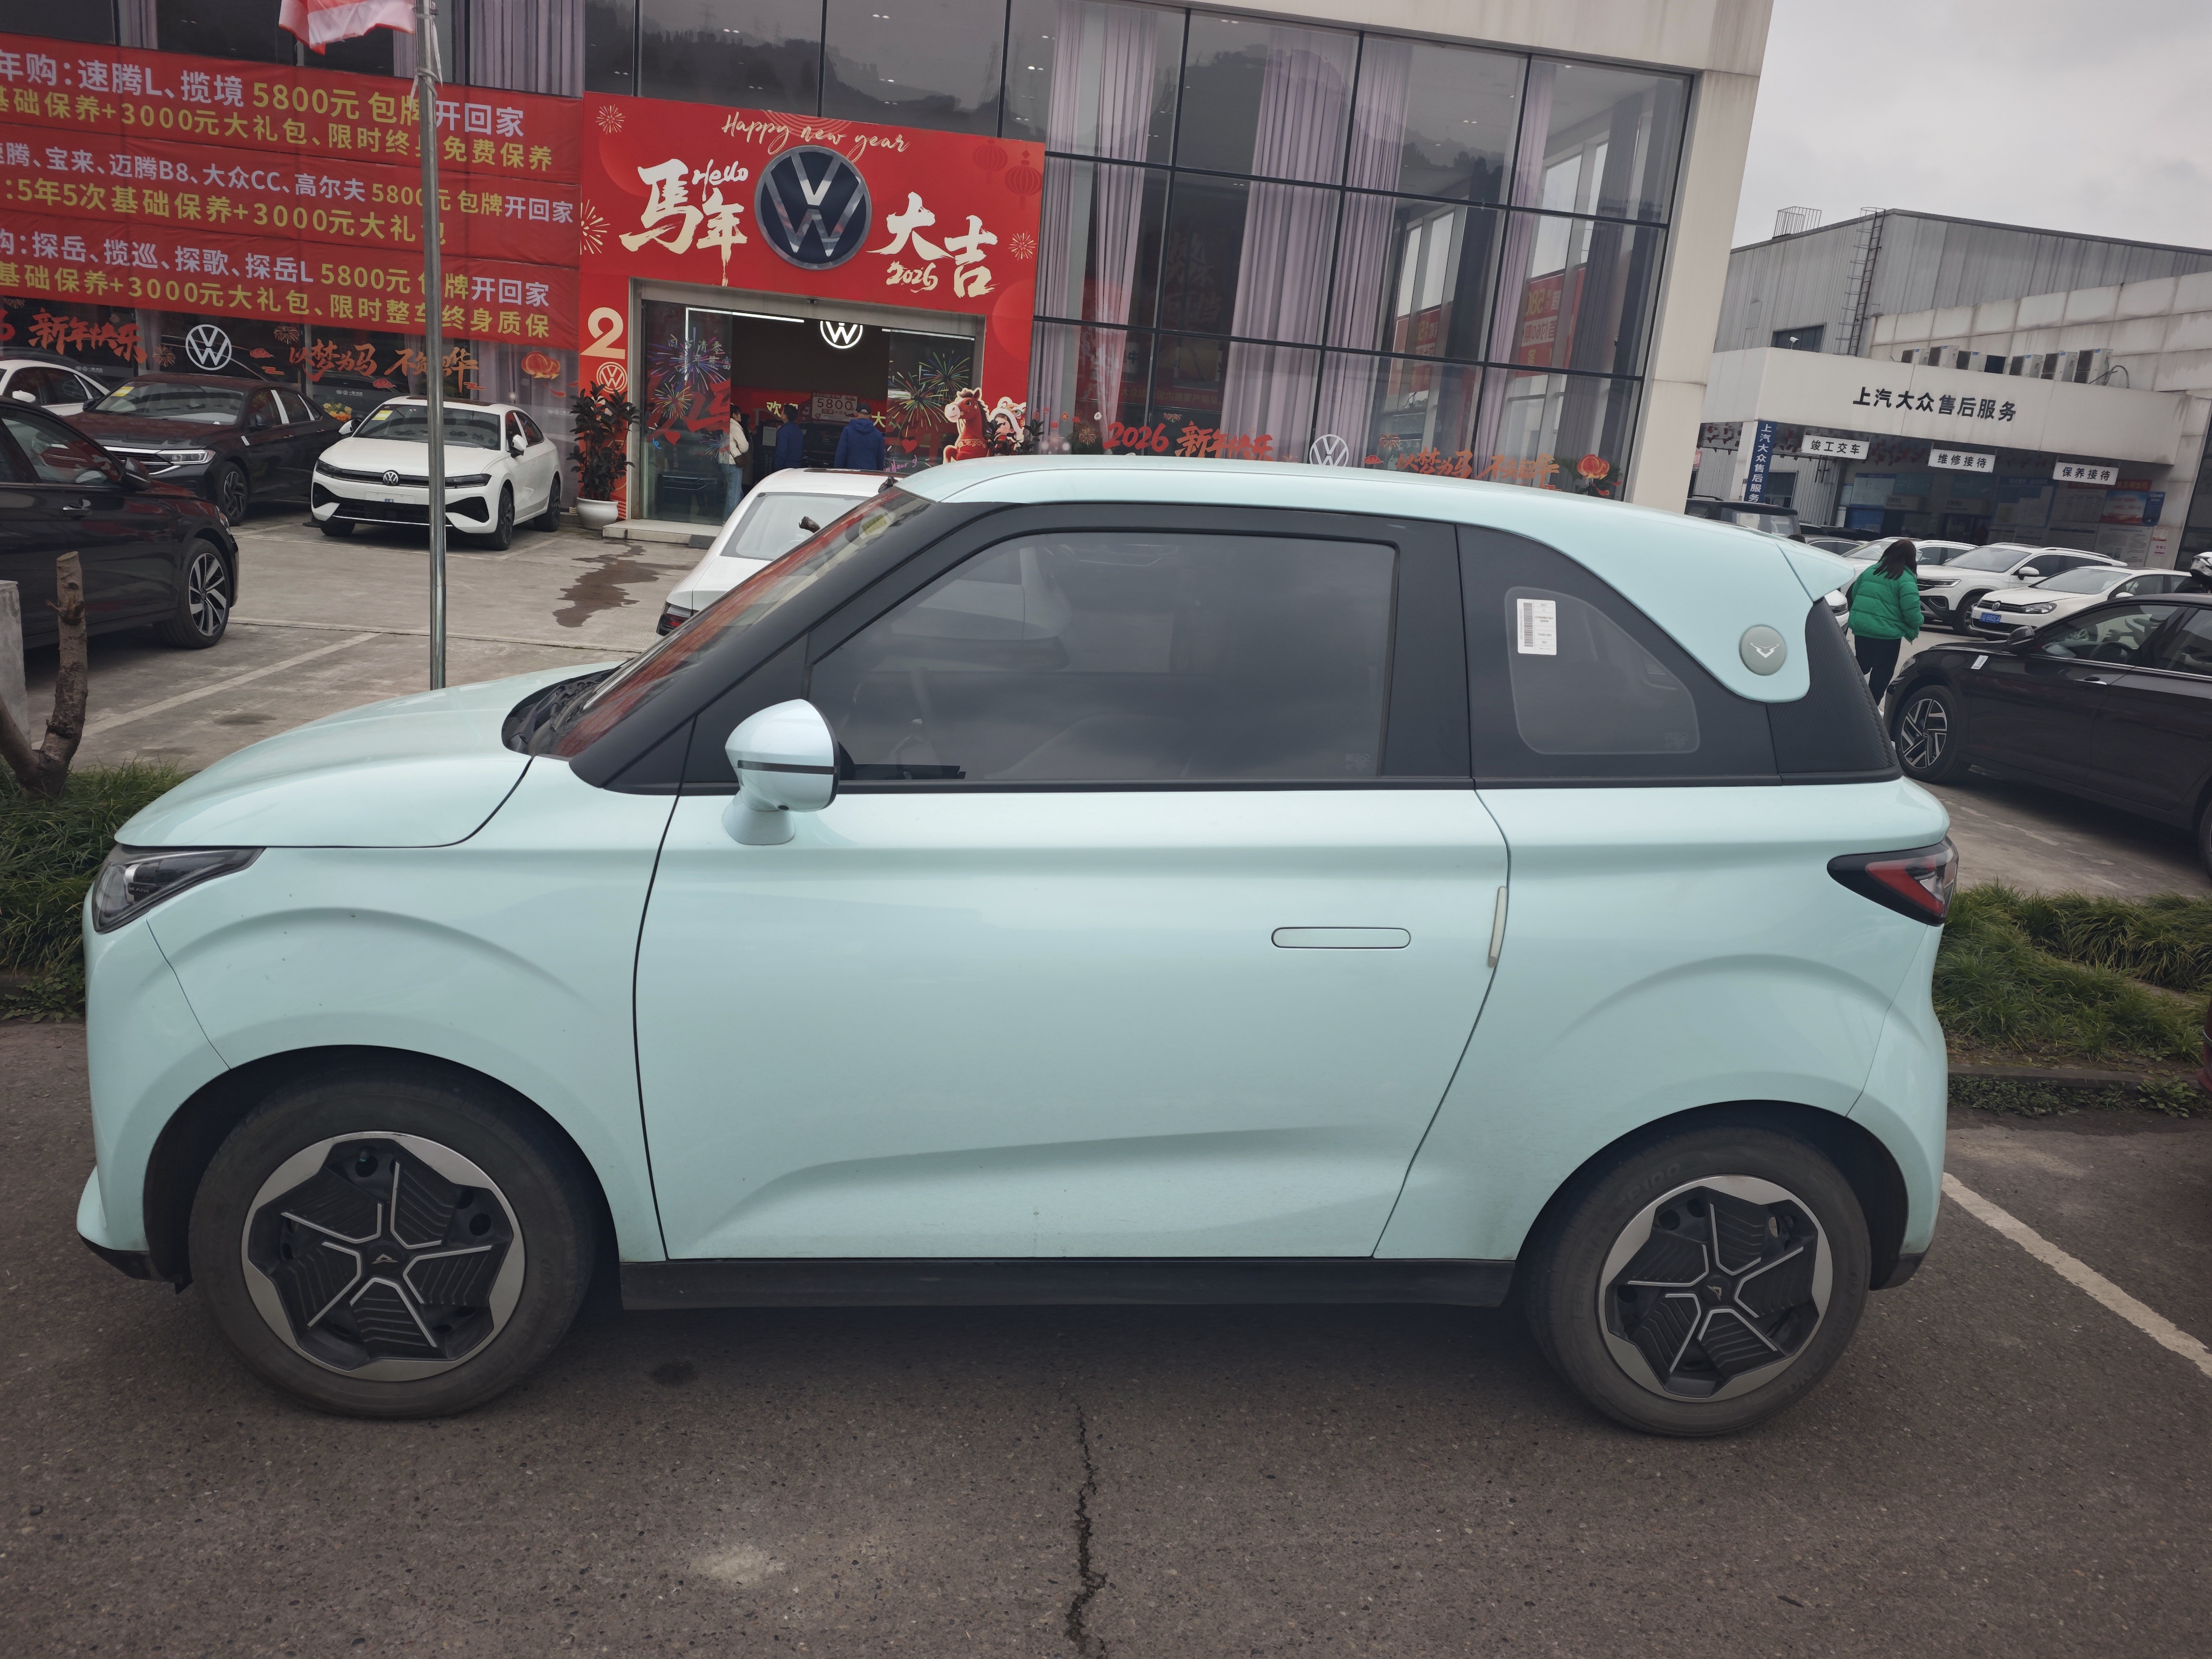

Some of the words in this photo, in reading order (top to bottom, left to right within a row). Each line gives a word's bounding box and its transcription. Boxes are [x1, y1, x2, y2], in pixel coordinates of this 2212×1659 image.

[252, 82, 360, 119] 5800元
[0, 85, 552, 171] 础保养+3000元大礼包、限时终免费保养
[722, 111, 790, 154] Happy
[800, 126, 846, 144] new
[847, 131, 911, 163] year
[0, 141, 366, 203] 腾、宝来、迈腾B8、大众CC、高尔夫
[458, 189, 574, 224] 包牌开回家
[692, 159, 750, 200] Hello
[866, 191, 998, 298] 大吉
[320, 263, 410, 295] 5800元
[417, 272, 550, 308] 牌开回家
[886, 260, 939, 293] 2026
[28, 307, 147, 364] 新年快乐
[185, 324, 232, 370] VW
[579, 307, 625, 360] 2
[289, 339, 377, 382] 以梦为马
[1852, 387, 2017, 423] 上汽大众售后服务
[1102, 421, 1170, 453] 2026
[1175, 420, 1274, 462] 新年快乐
[1397, 446, 1473, 479] 以梦为马
[1748, 423, 1772, 502] 上汽大众售后服务
[1810, 439, 1861, 455] 竣工交车
[1937, 453, 1987, 469] 维修接待
[2062, 466, 2110, 481] 保养接待
